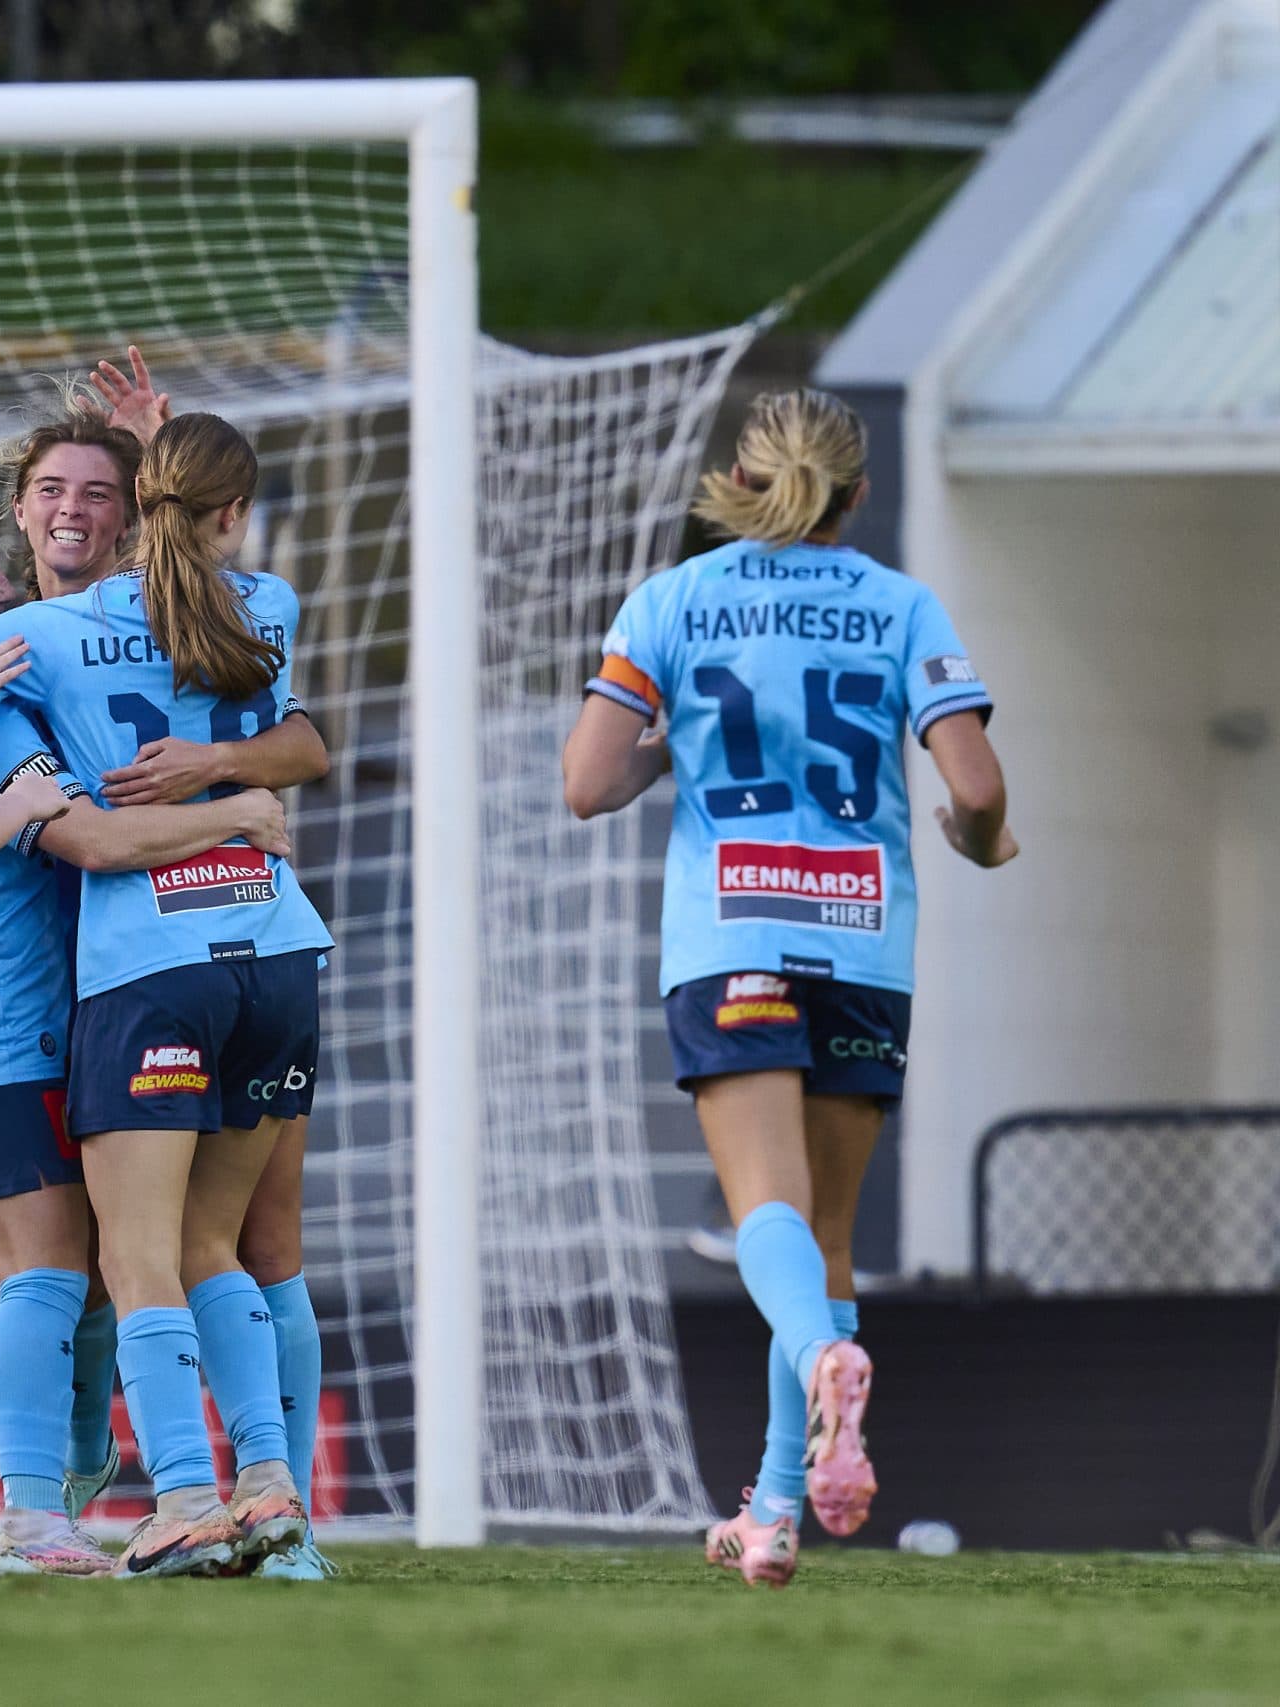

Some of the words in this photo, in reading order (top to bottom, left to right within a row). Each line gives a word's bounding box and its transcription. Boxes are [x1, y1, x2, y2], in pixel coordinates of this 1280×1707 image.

[739, 555, 866, 588] Liberty
[684, 603, 894, 647] HAWKESBY
[693, 665, 884, 824] 15
[234, 885, 271, 901] HIRE
[723, 865, 878, 895] KENNARDS
[821, 904, 878, 929] HIRE
[143, 1048, 200, 1069] MEGA
[130, 1073, 208, 1092] REWARDS
